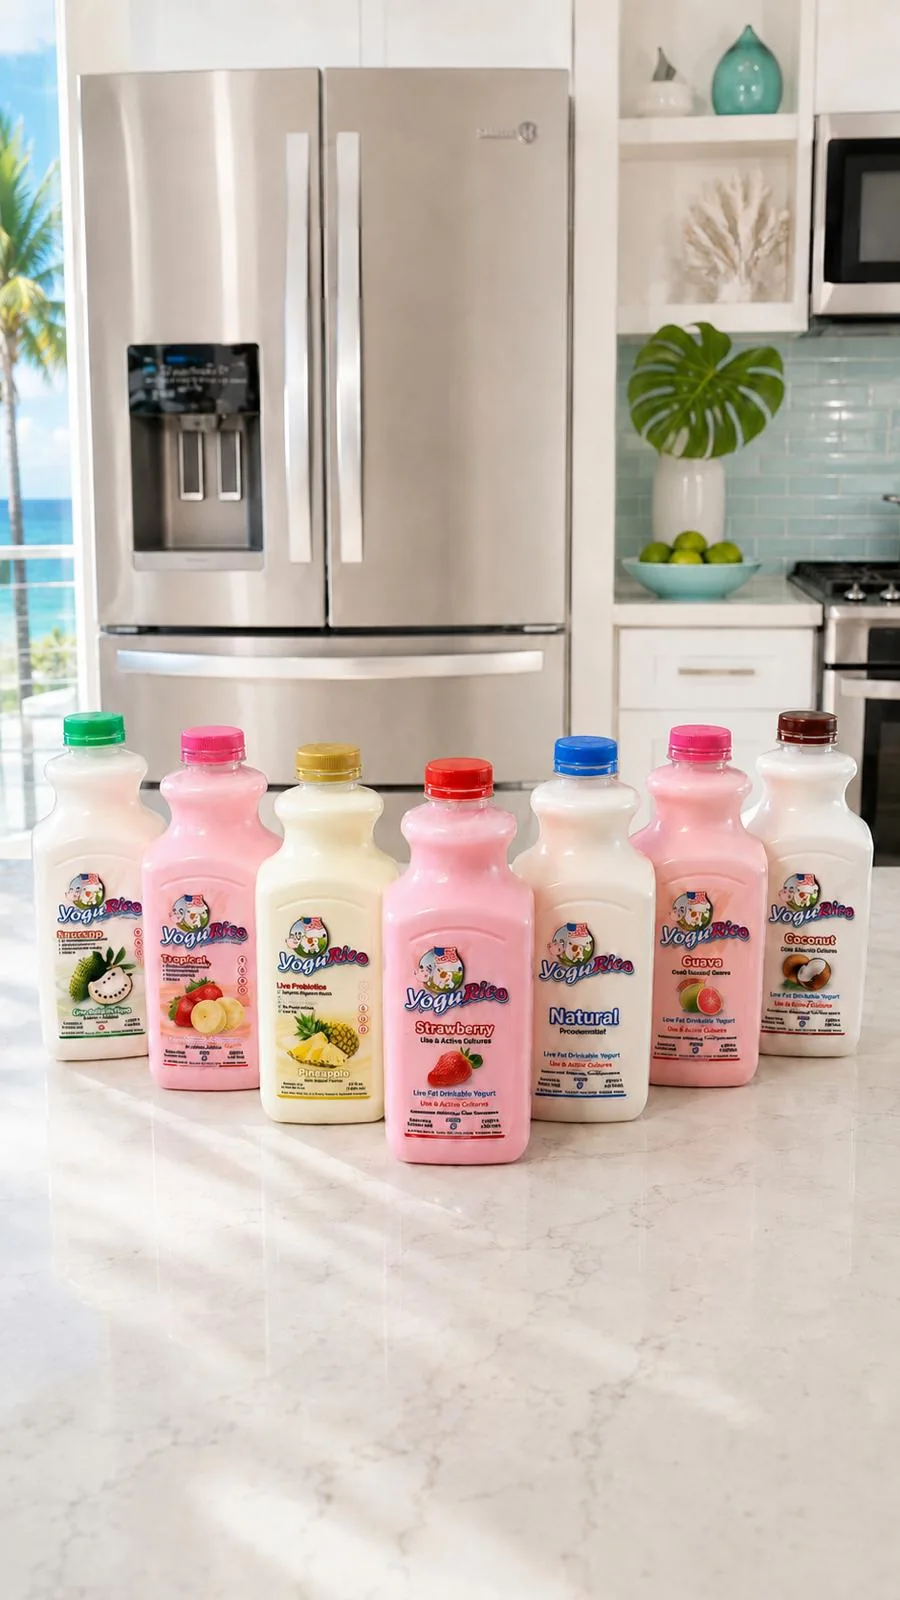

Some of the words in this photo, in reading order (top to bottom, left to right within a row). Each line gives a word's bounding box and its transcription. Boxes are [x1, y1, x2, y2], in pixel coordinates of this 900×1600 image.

[784, 932, 837, 946] Coconut
[682, 955, 723, 968] Guava
[549, 1007, 620, 1026] Natural
[415, 1021, 495, 1038] Strawberry
